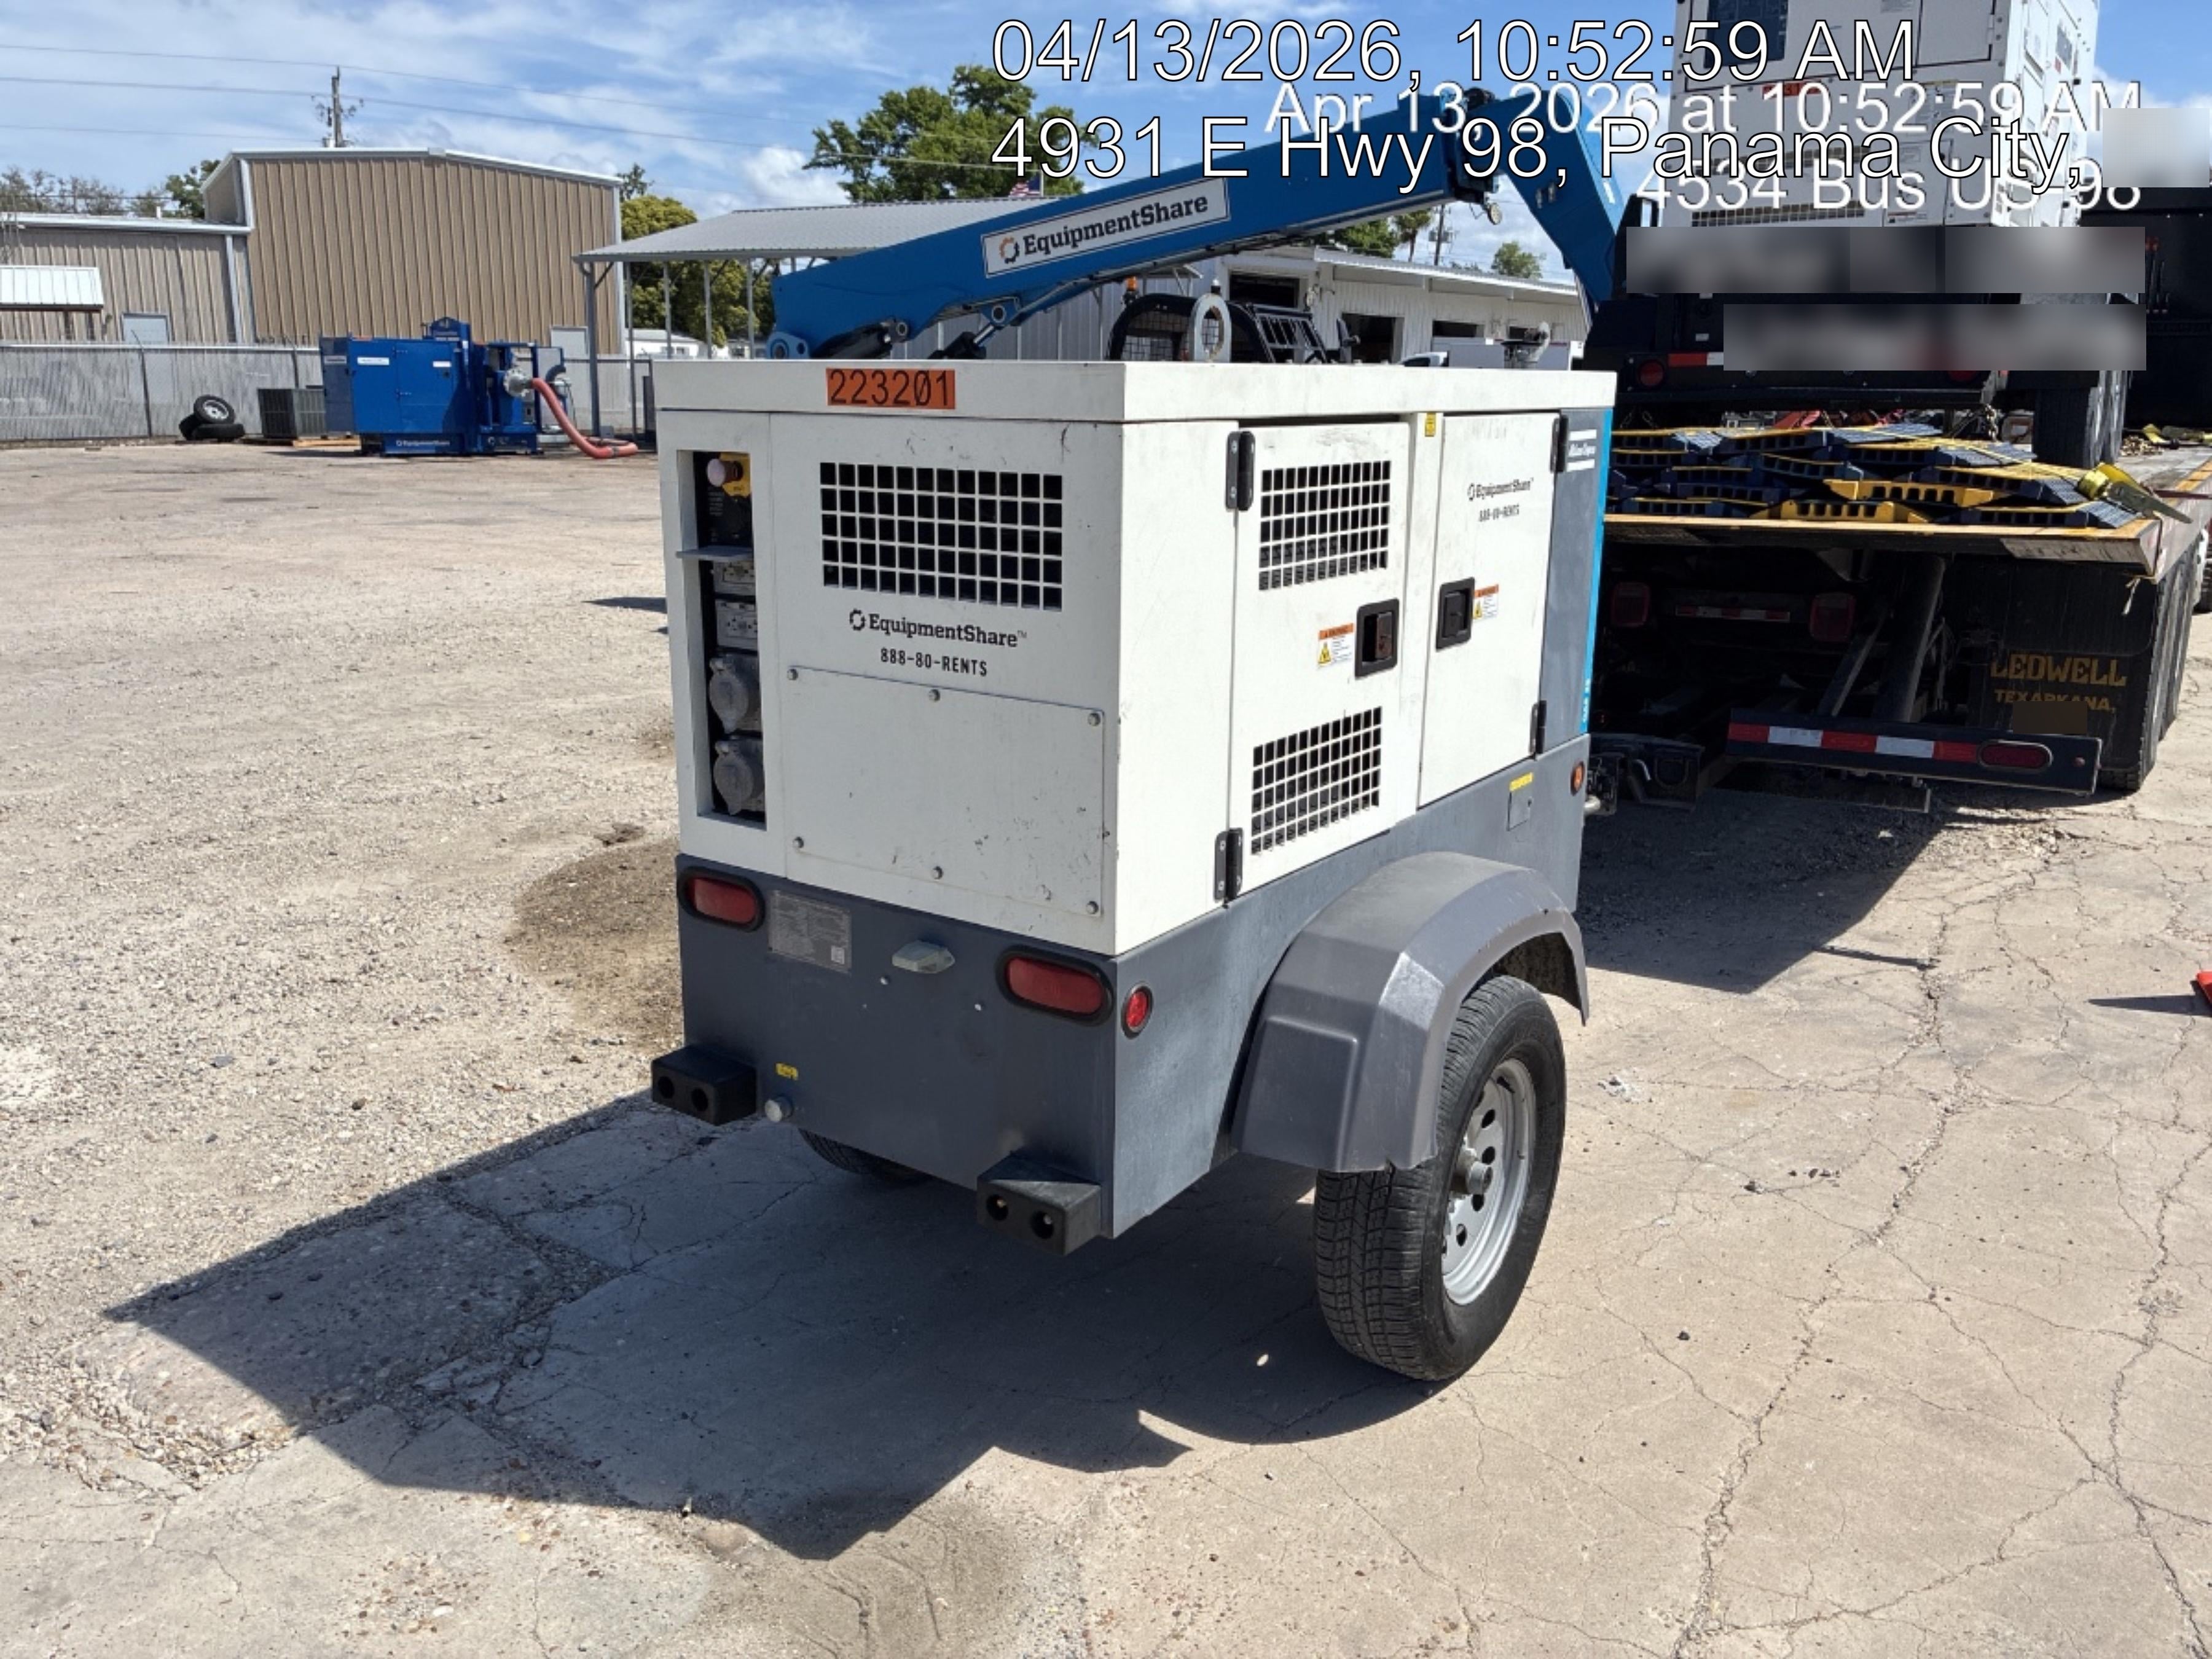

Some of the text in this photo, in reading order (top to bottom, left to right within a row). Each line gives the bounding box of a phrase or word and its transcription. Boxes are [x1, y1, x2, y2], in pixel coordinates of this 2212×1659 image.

[1022, 195, 1208, 256] EquipmentShare
[830, 369, 948, 406] 223201
[880, 647, 987, 677] 888-80-RENTS
[1990, 654, 2127, 686] LEDWELL
